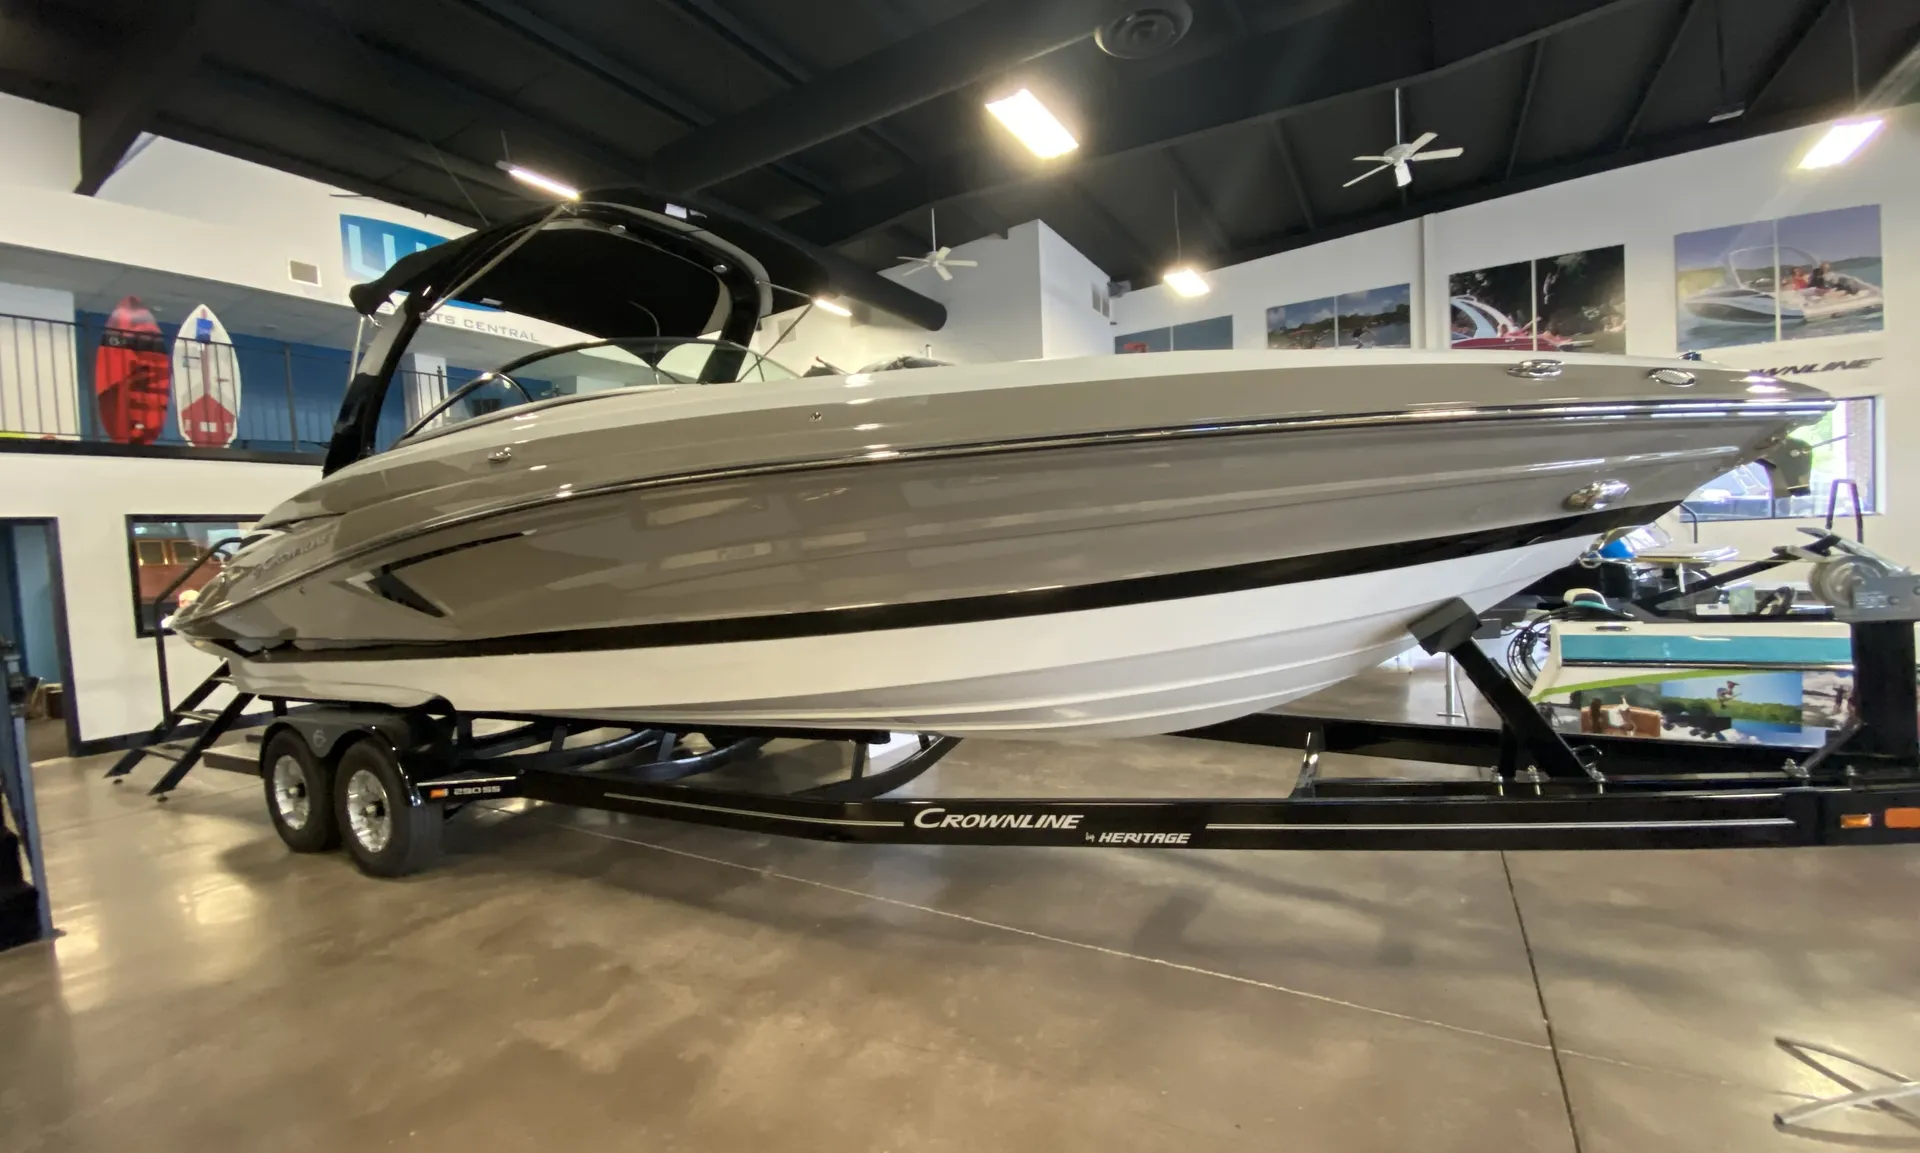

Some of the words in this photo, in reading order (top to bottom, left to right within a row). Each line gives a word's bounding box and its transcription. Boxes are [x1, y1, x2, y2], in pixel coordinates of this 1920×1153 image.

[464, 319, 539, 342] CENTRAL
[913, 807, 1084, 830] CROWNLINE
[1098, 832, 1192, 844] HERITAGE
